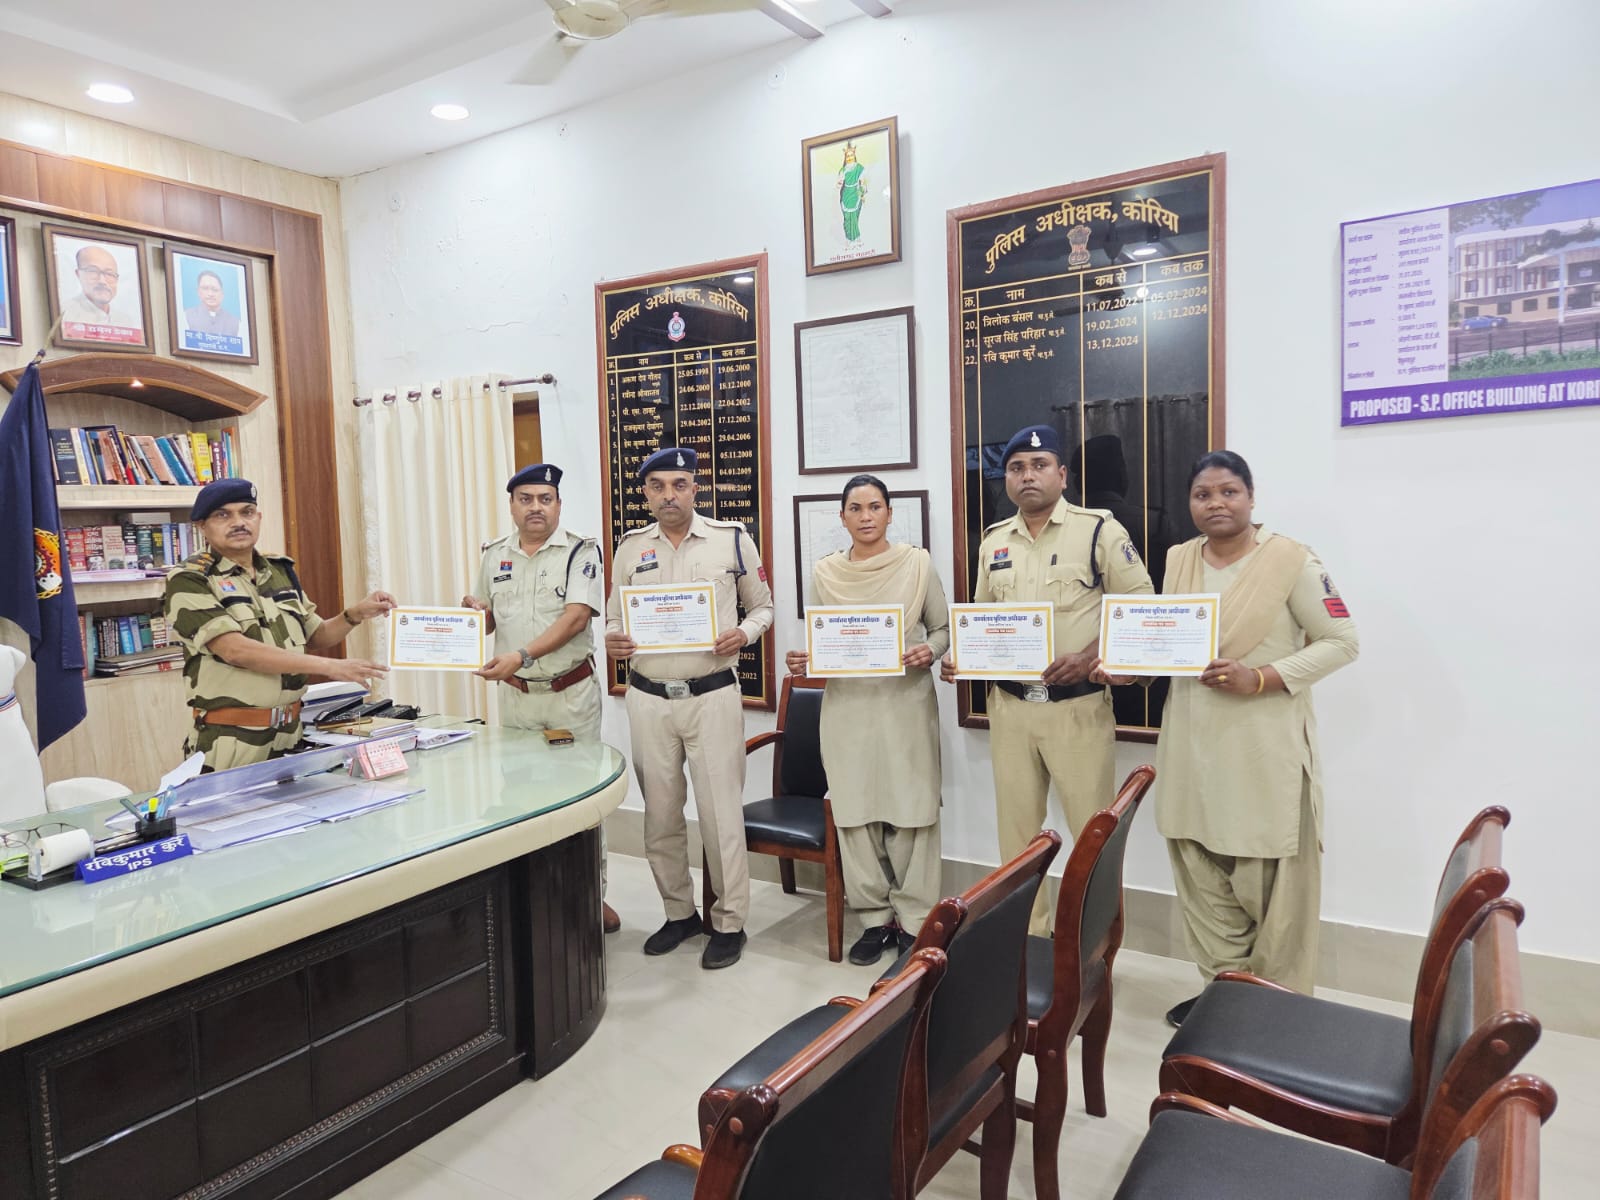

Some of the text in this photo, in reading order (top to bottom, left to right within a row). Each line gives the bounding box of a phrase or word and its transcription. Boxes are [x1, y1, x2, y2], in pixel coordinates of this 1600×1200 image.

[985, 196, 1179, 274] पुलिस अधीक्षक, कोरिया
[964, 260, 1204, 307] क्र. नाम कब से कब तक
[609, 286, 749, 340] पुलिस अधीक्षक, कोरिया
[965, 321, 977, 330] 20.
[983, 313, 1011, 327] त्रिलोक
[1012, 311, 1033, 323] बंसल
[1086, 297, 1138, 312] 11.07.2022
[965, 339, 978, 348] 21.
[983, 334, 1001, 348] सूरज
[1003, 330, 1019, 343] सिंह
[1021, 327, 1046, 340] परिहार
[1086, 317, 1137, 332] 19.02.2024
[638, 358, 649, 366] नाम
[683, 353, 695, 361] कब
[696, 350, 702, 360] से
[721, 349, 733, 357] कब
[734, 348, 746, 356] तक
[965, 356, 978, 365] 22.
[983, 350, 996, 362] रवि
[1000, 350, 1020, 363] कुमार
[1087, 335, 1139, 350] 13.12.2024
[718, 363, 751, 374] 19.06.2000
[679, 384, 710, 394] 24.06.2000
[719, 380, 752, 390] 18.12.2000
[680, 401, 711, 411] 22.12.2000
[719, 398, 751, 407] 22.04.2002
[1350, 396, 1412, 418] PROPOSED
[1420, 393, 1441, 413] S.P.
[1442, 389, 1484, 411] OFFICE
[1485, 383, 1546, 408] BUILDING
[1548, 382, 1566, 402] AT
[1566, 378, 1600, 400] KORI
[680, 418, 711, 428] 29.04.2002
[718, 415, 751, 424] 17.12.2003
[718, 433, 751, 442] 29.04.2006
[720, 450, 753, 459] 05.11.2008
[719, 467, 752, 476] 04.01.2009
[720, 500, 751, 508] 15.06.2010
[128, 858, 153, 871] IPS
